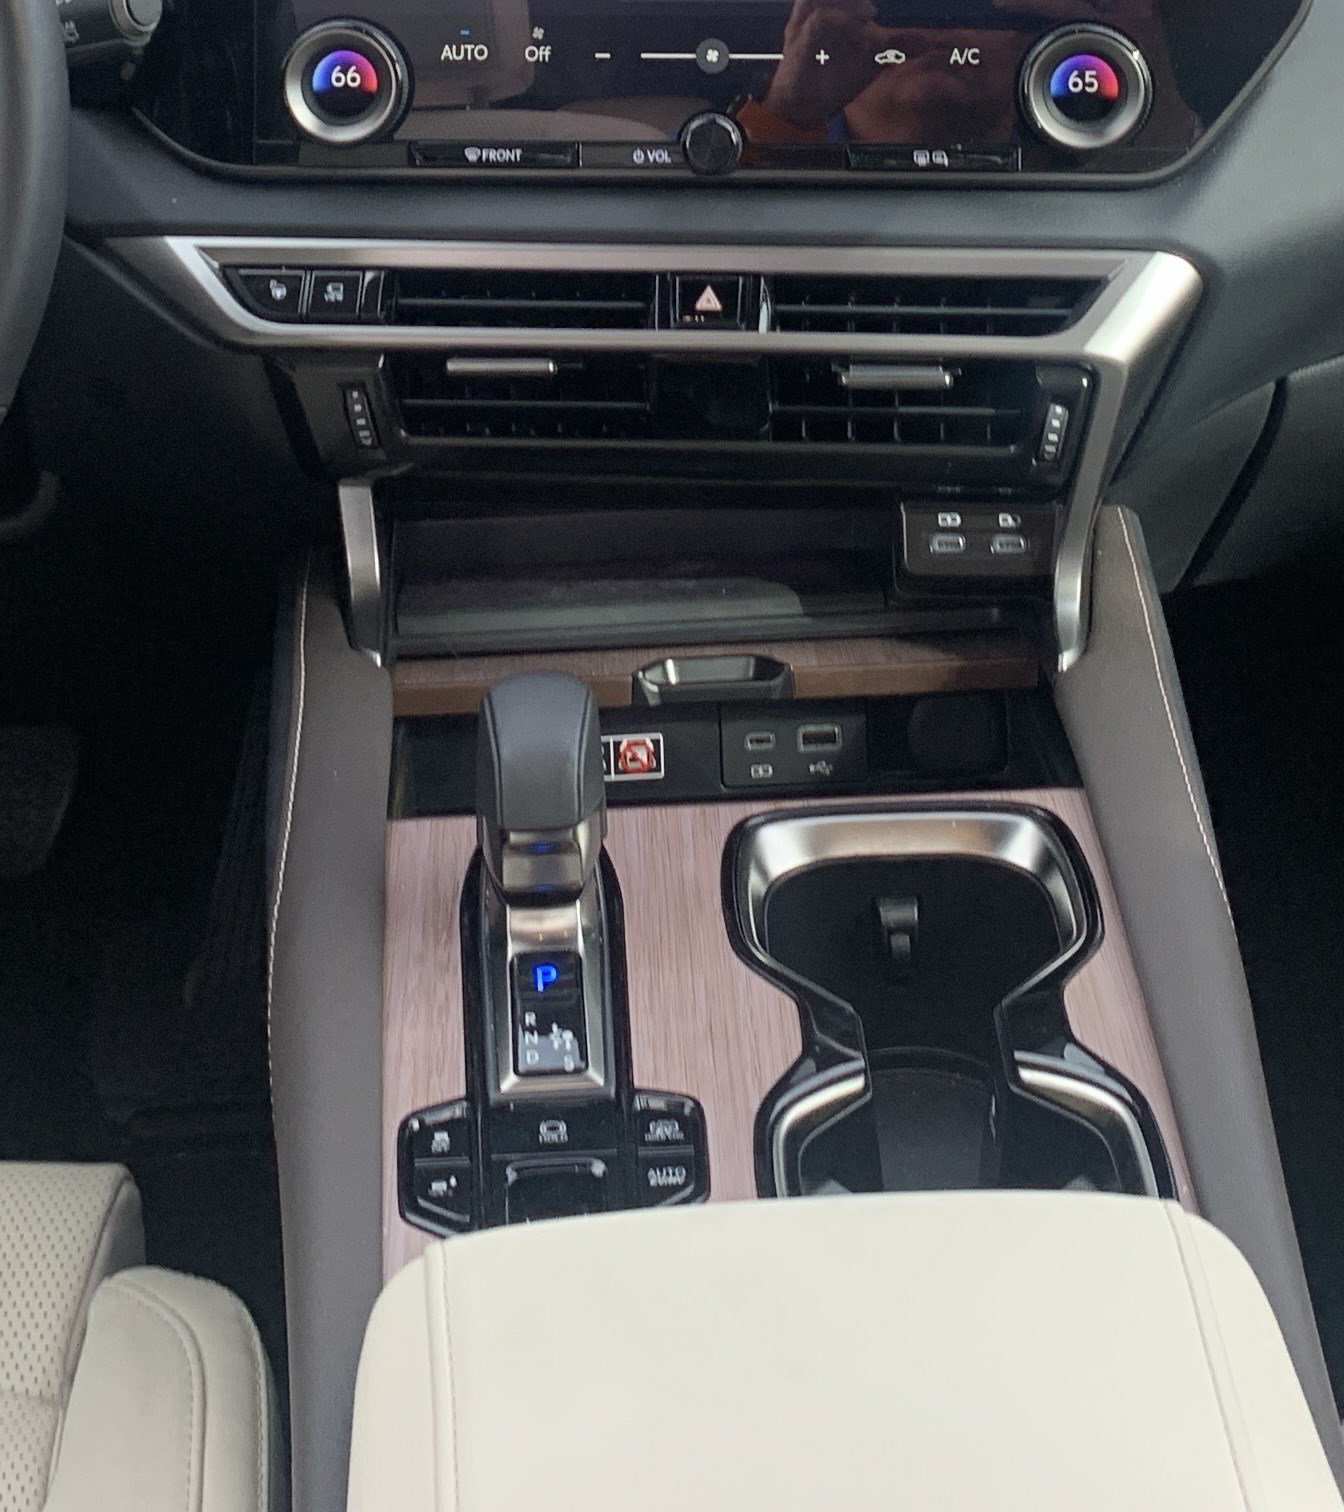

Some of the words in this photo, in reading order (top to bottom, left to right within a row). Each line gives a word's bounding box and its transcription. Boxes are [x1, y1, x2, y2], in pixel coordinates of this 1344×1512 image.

[440, 44, 489, 62] AUTO
[524, 45, 552, 63] Off
[949, 48, 980, 67] A/C
[330, 66, 362, 88] 66
[1067, 72, 1099, 94] 65
[482, 149, 523, 164] FRONT
[646, 149, 672, 165] VOL
[536, 965, 557, 993] P
[524, 1029, 538, 1046] N
[526, 1049, 539, 1065] D
